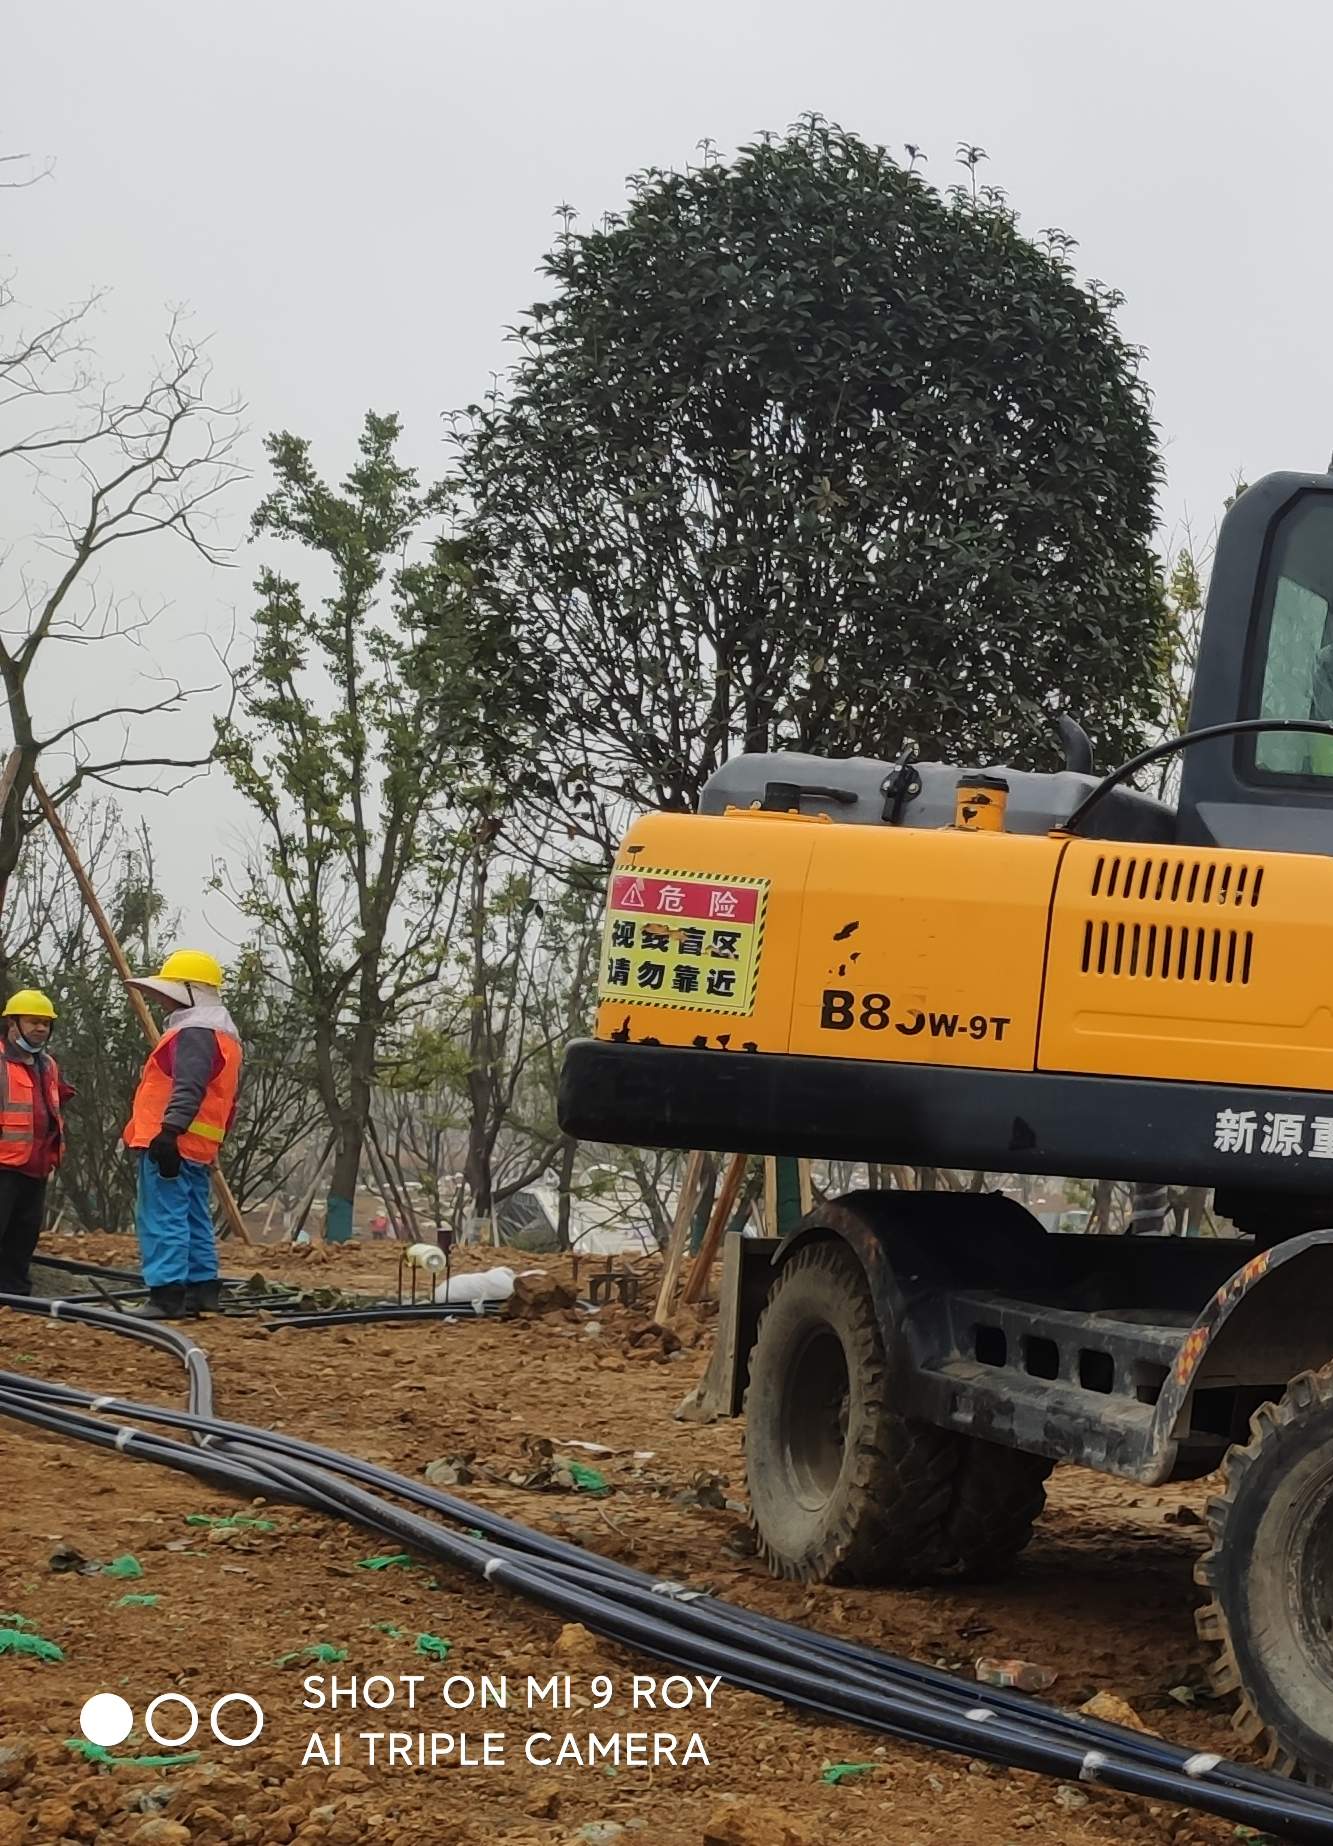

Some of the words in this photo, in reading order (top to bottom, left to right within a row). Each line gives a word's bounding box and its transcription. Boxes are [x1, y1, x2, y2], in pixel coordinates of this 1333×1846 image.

[656, 884, 739, 918] 危险
[606, 957, 737, 998] 请勿靠近
